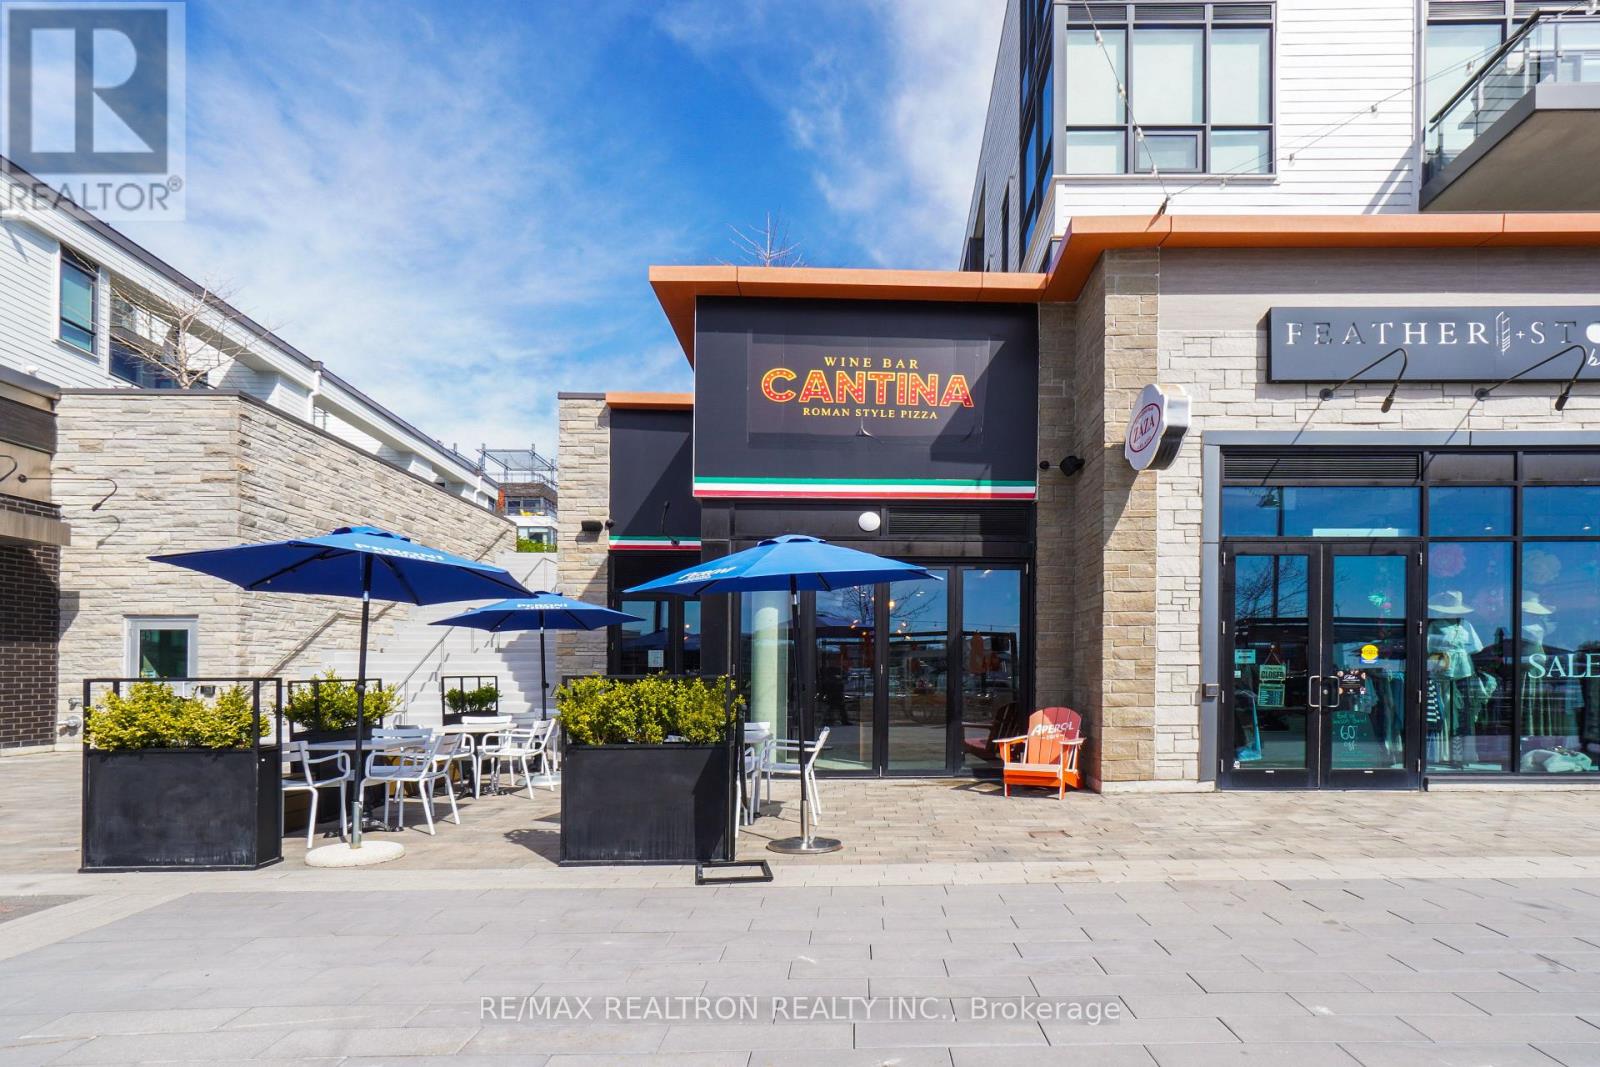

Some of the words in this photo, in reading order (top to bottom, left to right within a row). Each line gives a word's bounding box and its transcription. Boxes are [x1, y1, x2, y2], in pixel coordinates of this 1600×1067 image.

[1285, 321, 1490, 345] FEATHER
[824, 356, 872, 368] WINE
[883, 358, 919, 369] BAR
[761, 367, 974, 407] CANTINA
[803, 407, 850, 417] ROMAN
[855, 408, 895, 418] STYLE
[900, 409, 938, 419] PIZZA
[1528, 653, 1600, 678] SALE
